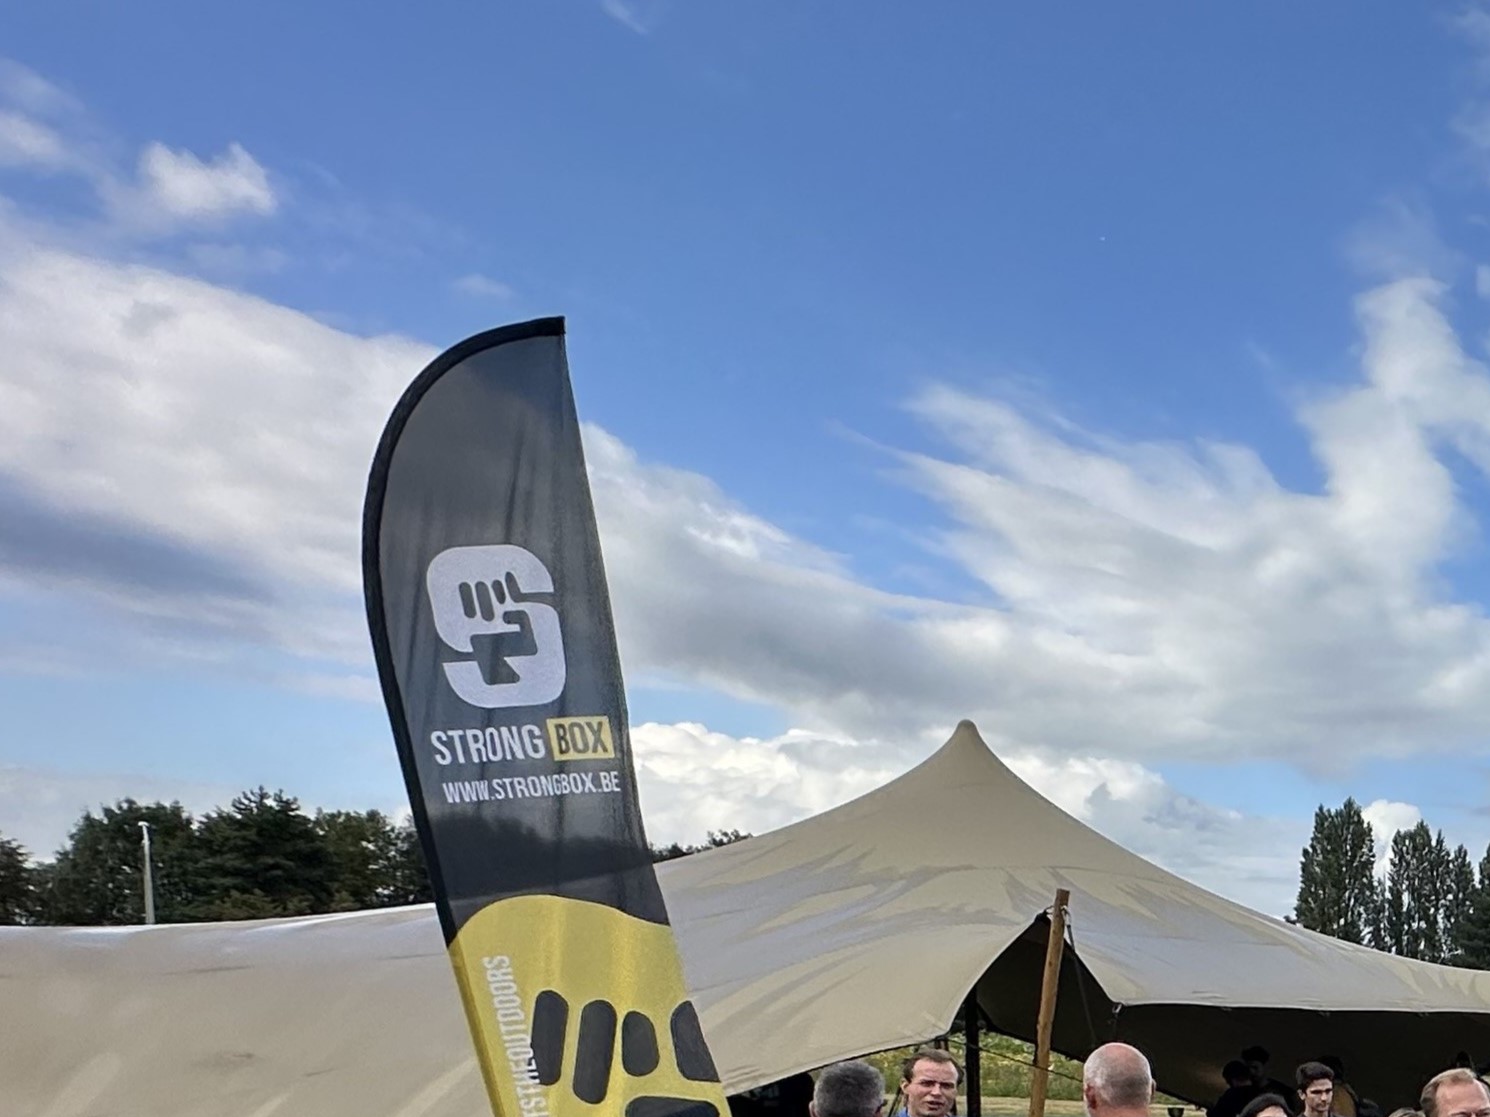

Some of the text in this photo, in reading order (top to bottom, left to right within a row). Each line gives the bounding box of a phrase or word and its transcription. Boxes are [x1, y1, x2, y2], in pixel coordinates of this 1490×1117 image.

[430, 720, 609, 766] STRONG BOX
[442, 771, 621, 804] WWW.STRONGBOX.BE
